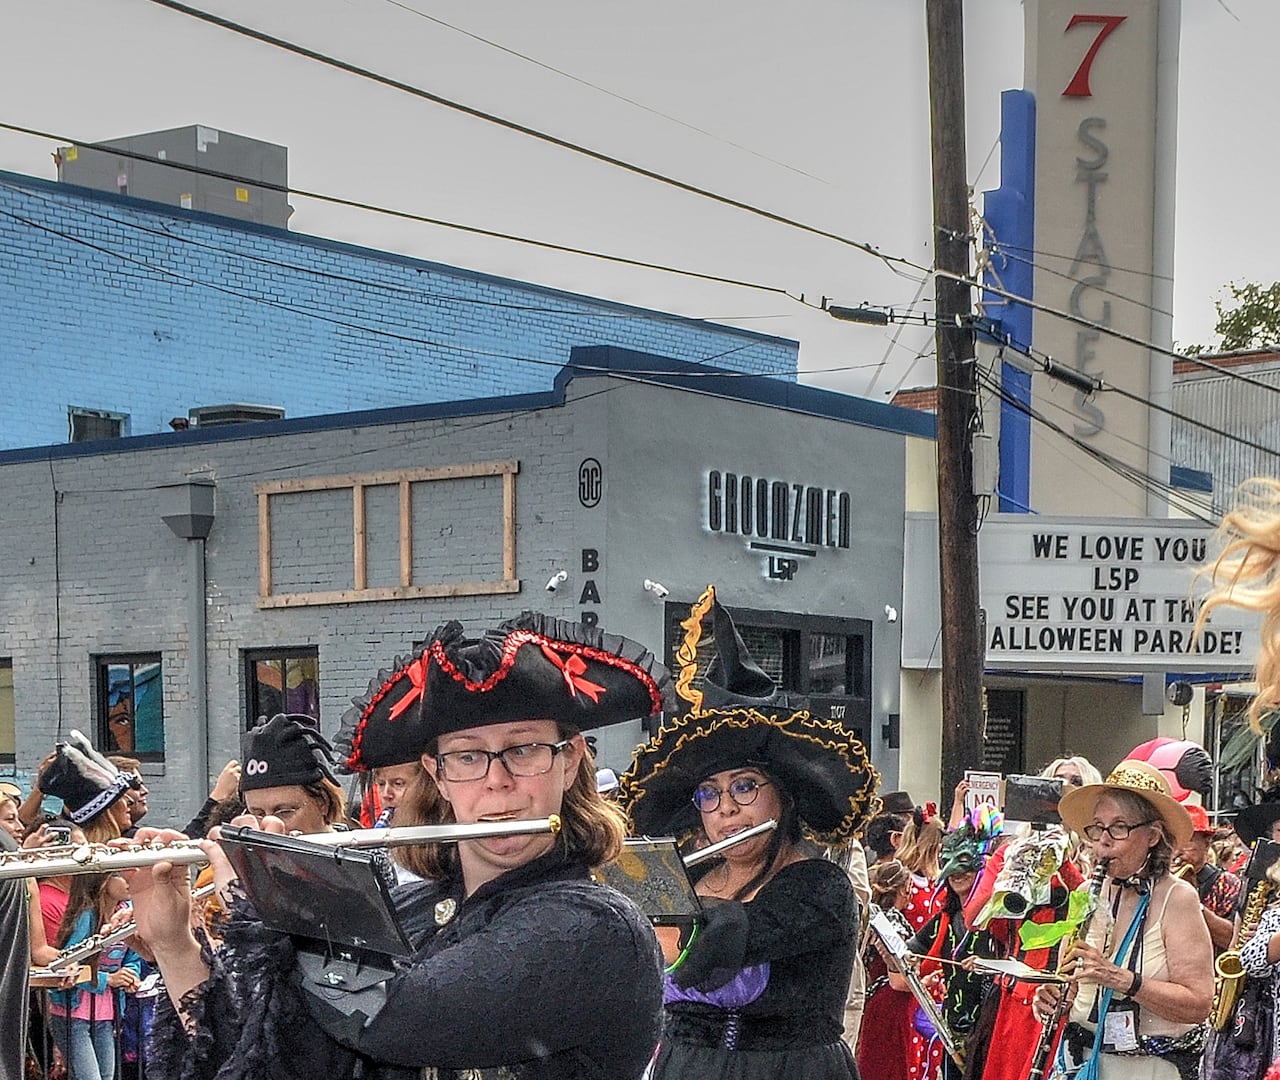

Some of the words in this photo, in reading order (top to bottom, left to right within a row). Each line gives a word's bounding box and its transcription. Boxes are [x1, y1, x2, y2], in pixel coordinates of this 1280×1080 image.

[1062, 14, 1127, 96] 7
[1069, 117, 1111, 437] STAGES
[1032, 535, 1069, 559] WE
[1080, 536, 1144, 561] LOVE
[1155, 537, 1207, 561] YOU
[1094, 567, 1139, 591] L5P
[1006, 596, 1049, 620] SEE
[1063, 597, 1114, 621] YOU
[1125, 599, 1155, 622] AT
[991, 626, 1122, 651] ALLOWEEN
[1134, 630, 1242, 654] PARADE!
[974, 794, 996, 808] NO
